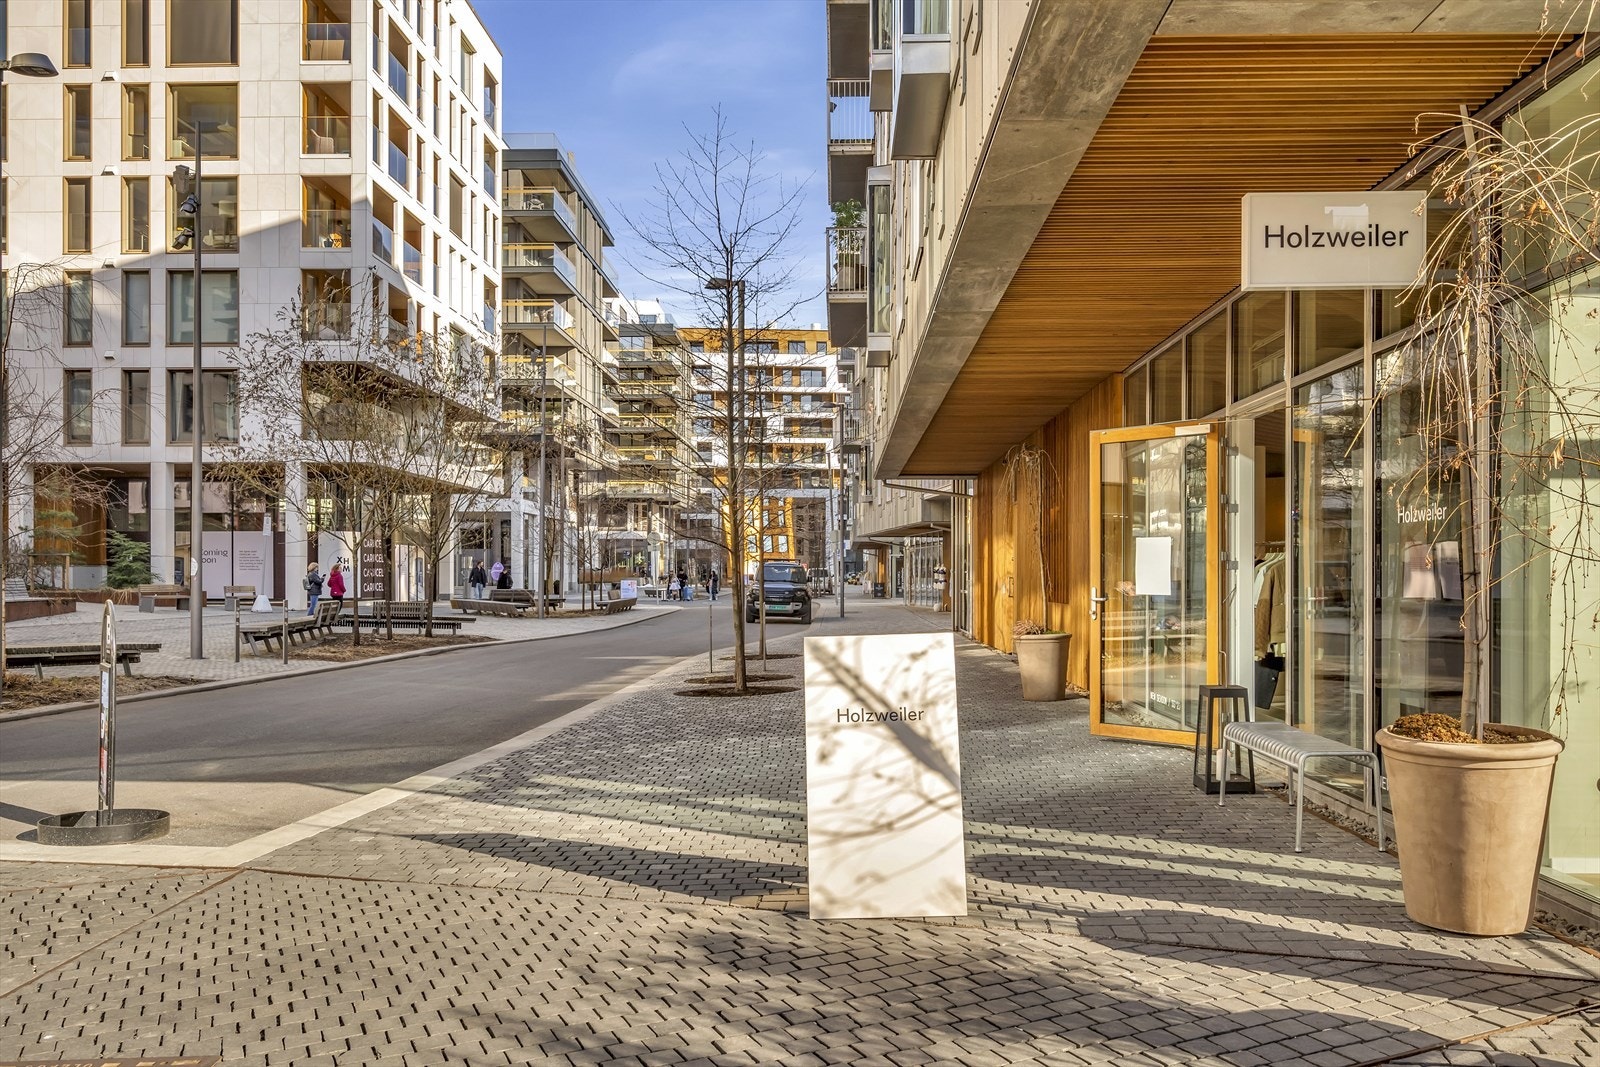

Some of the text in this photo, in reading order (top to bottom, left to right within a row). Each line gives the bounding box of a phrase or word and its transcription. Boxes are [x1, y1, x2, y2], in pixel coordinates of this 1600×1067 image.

[1264, 224, 1409, 248] Holzweiler
[1397, 502, 1448, 524] Holzweiler
[837, 706, 924, 723] Holzweiler
